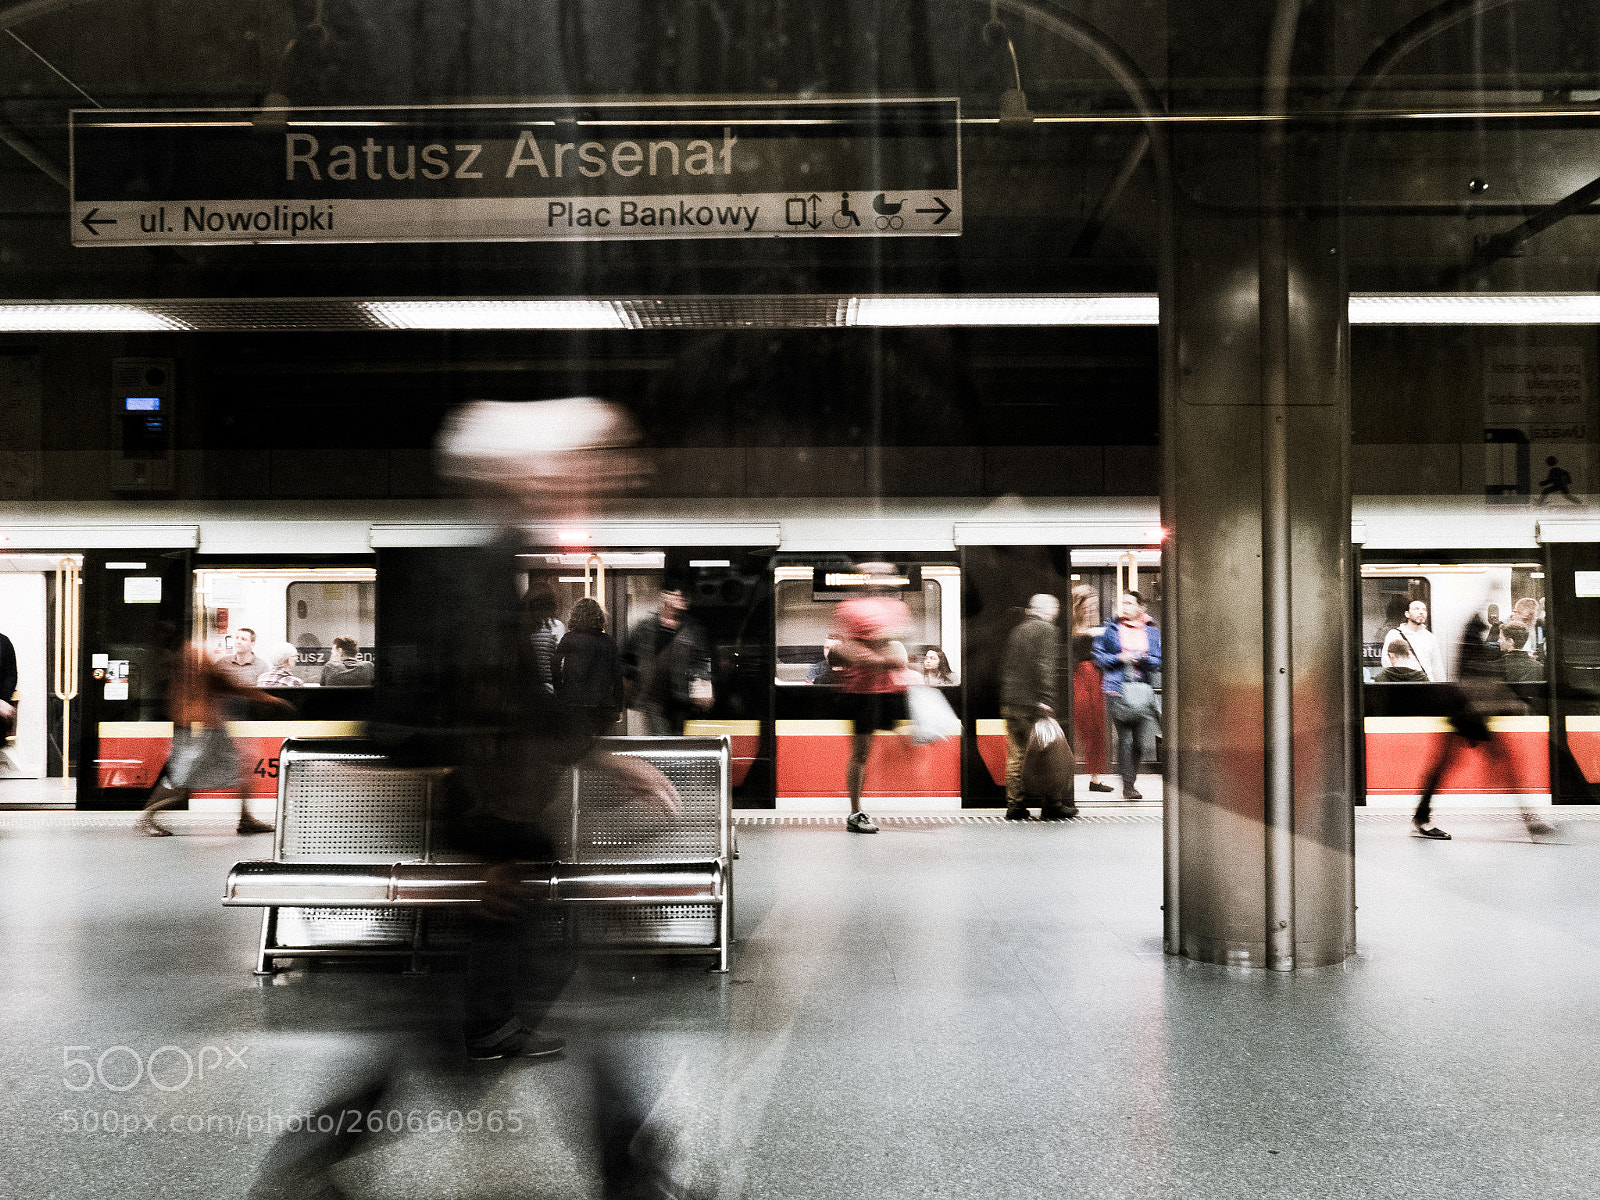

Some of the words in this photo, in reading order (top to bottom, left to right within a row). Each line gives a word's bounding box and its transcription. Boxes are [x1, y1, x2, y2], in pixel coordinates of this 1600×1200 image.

[285, 132, 484, 182] Ratusz
[505, 127, 738, 179] Arsenał
[139, 206, 173, 233] ul.
[183, 205, 335, 237] Nowolipki
[547, 200, 611, 228] Plac
[619, 200, 760, 232] Bankowy
